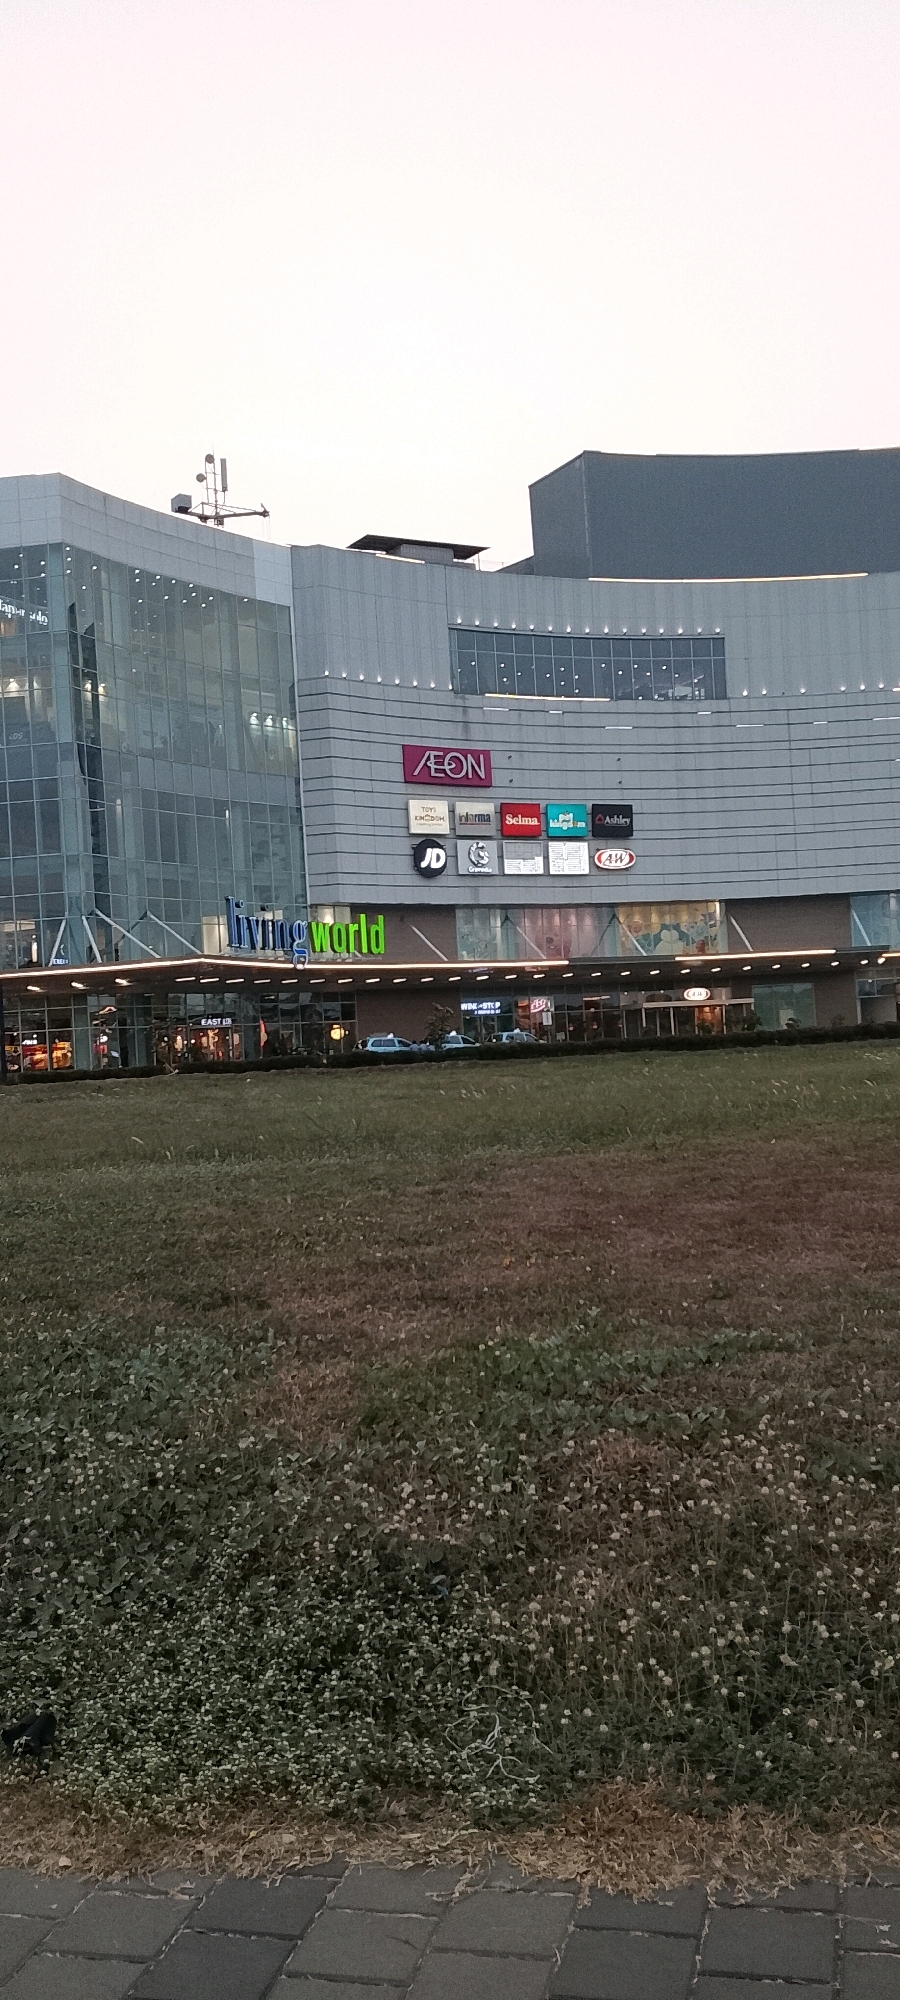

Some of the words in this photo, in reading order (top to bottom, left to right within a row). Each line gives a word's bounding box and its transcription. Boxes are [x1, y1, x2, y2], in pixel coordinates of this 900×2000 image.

[458, 811, 492, 823] informa
[505, 813, 540, 826] Selma
[604, 814, 630, 826] Ashley
[420, 847, 446, 869] JD
[200, 1018, 221, 1026] EAST
